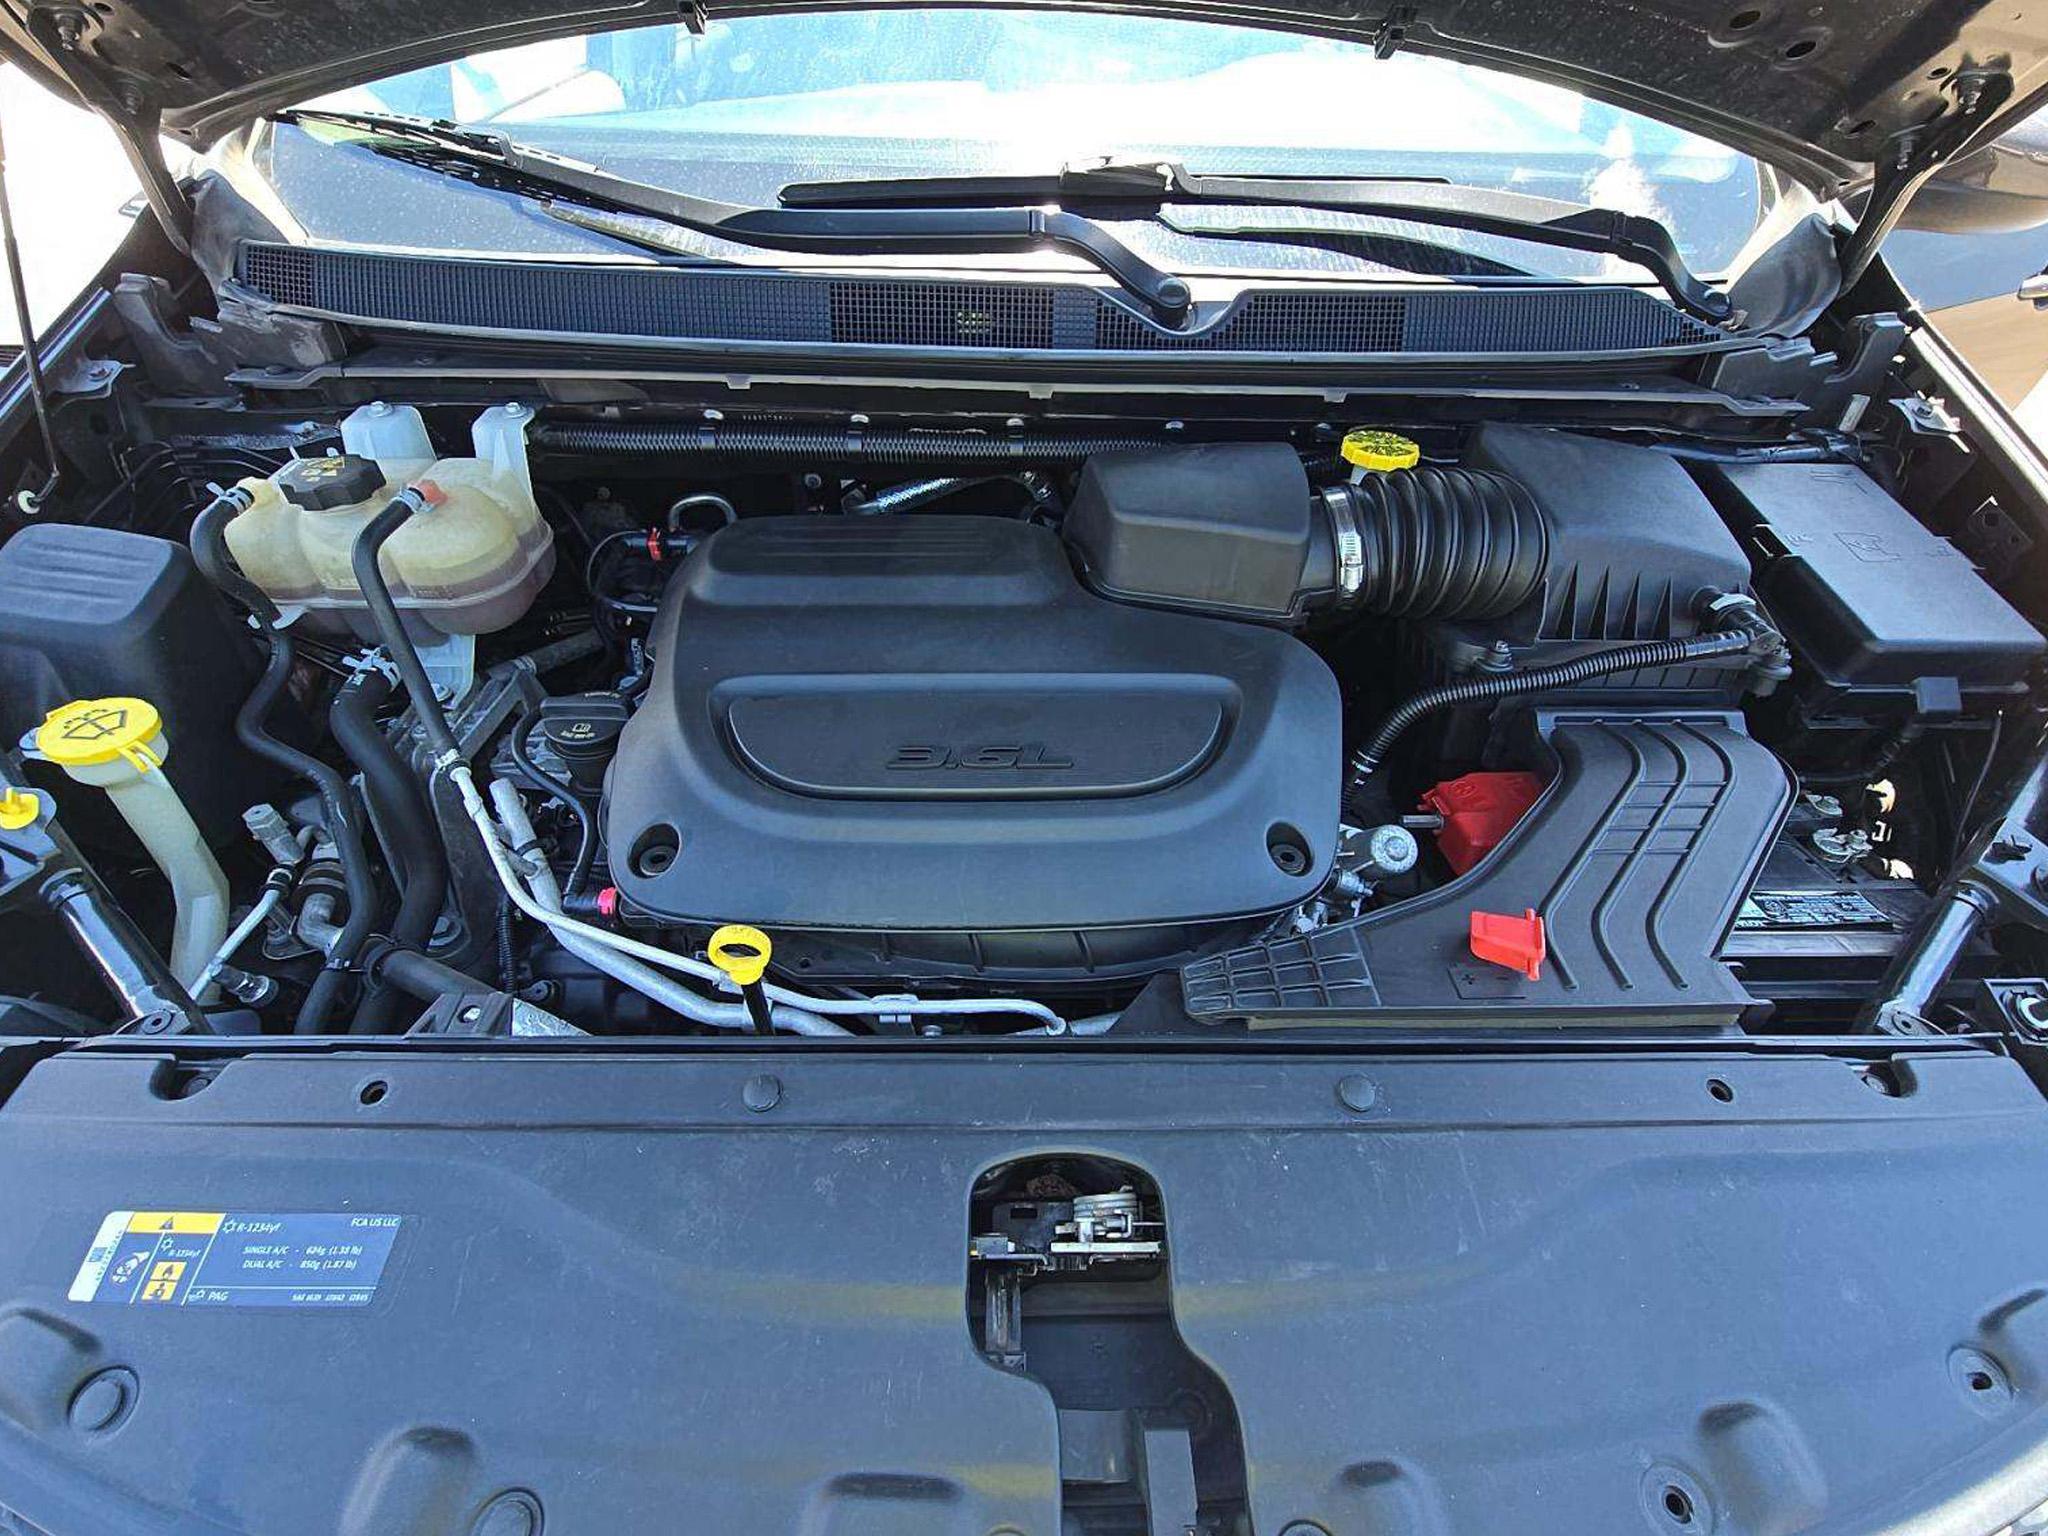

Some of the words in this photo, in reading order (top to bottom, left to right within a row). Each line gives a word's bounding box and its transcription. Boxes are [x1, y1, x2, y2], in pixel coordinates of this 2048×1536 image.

[886, 745, 1074, 770] 3.6L
[236, 1222, 281, 1234] R-1234yf
[351, 1218, 368, 1227] FCA
[369, 1218, 382, 1227] US
[383, 1218, 399, 1227] LLC
[242, 1246, 272, 1255] SINGLE
[272, 1245, 290, 1256] A/C
[242, 1259, 265, 1269] DUAL
[266, 1259, 285, 1269] A/C
[300, 1260, 320, 1270] 850g
[208, 1291, 229, 1301] PAG
